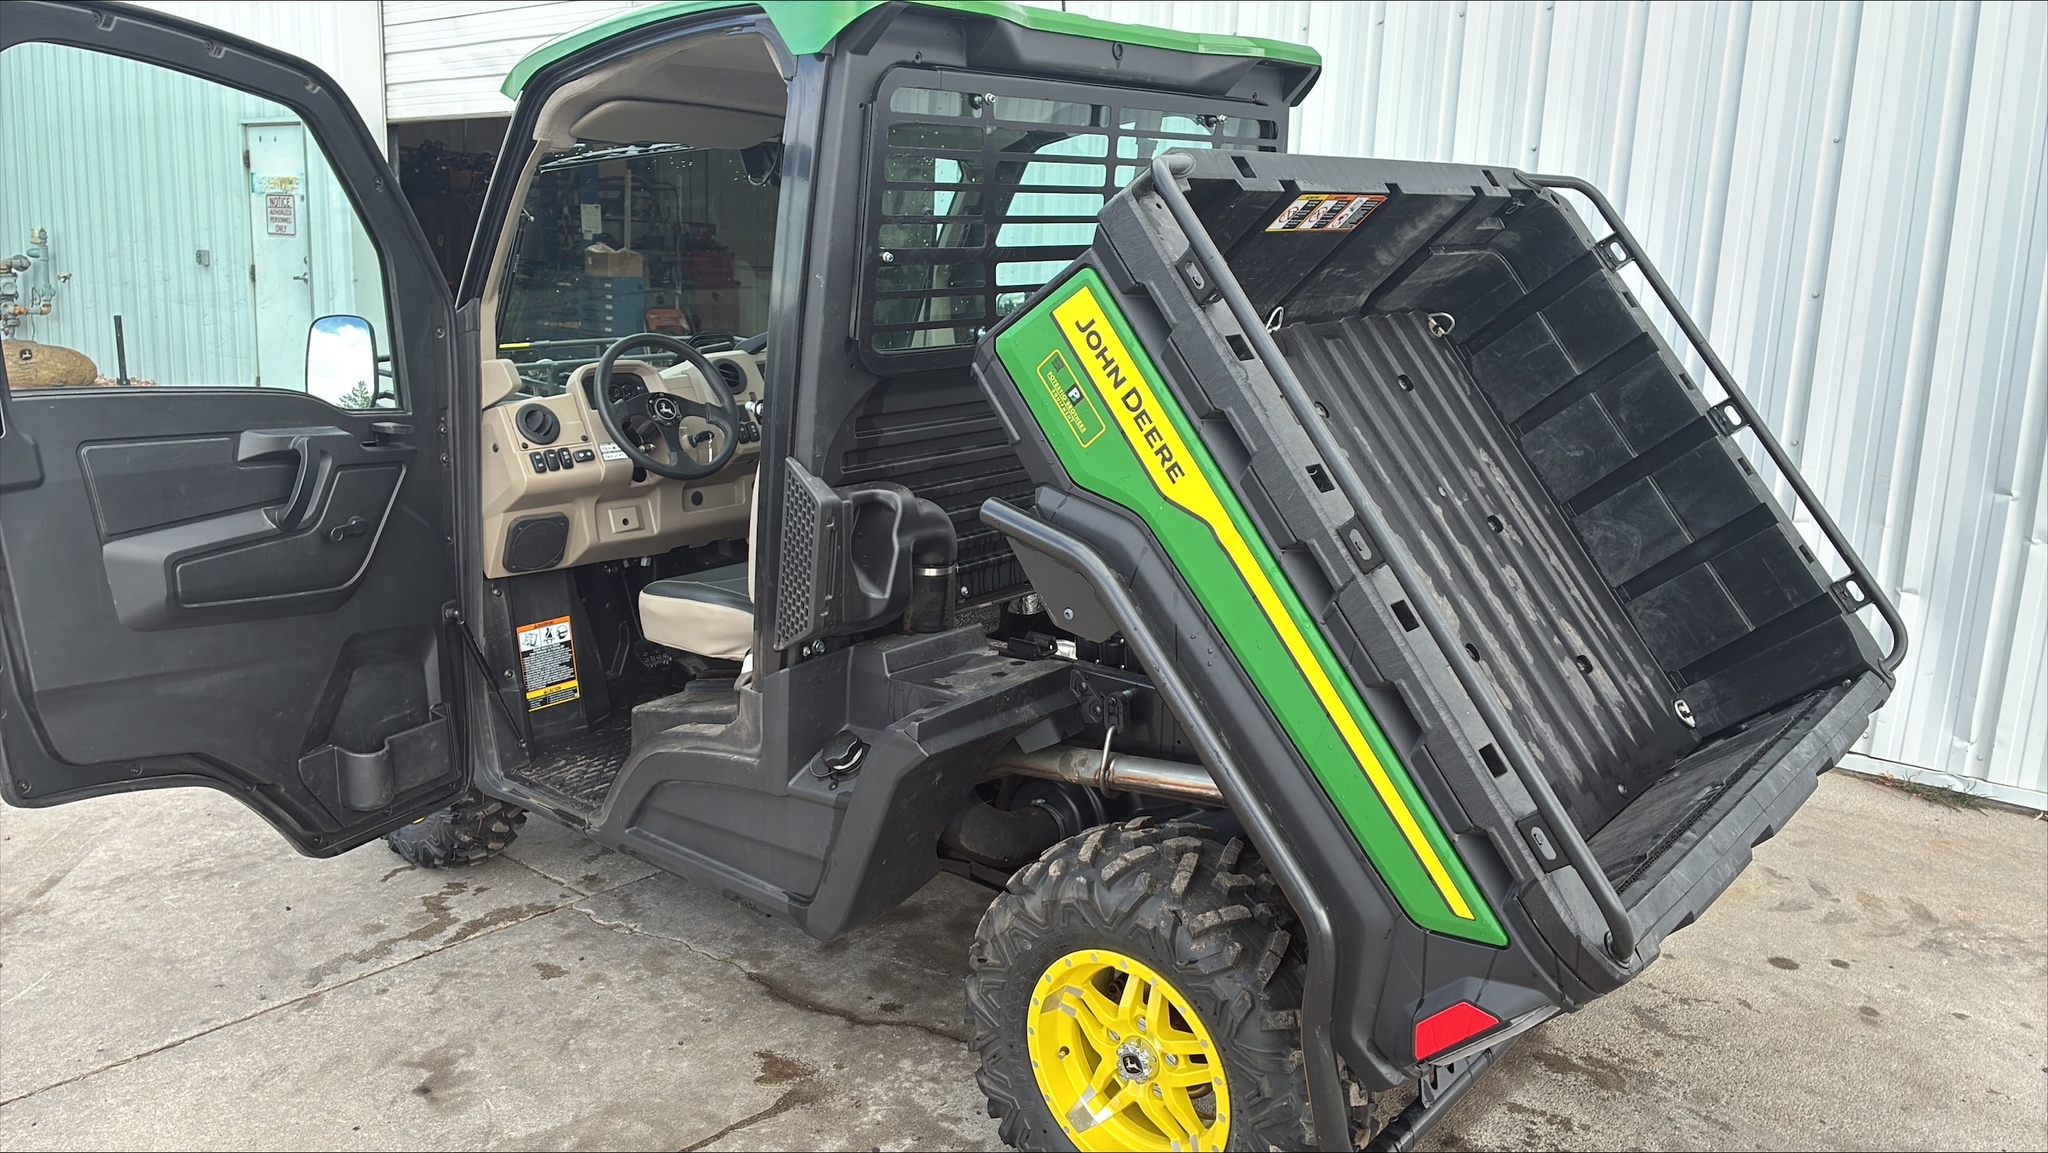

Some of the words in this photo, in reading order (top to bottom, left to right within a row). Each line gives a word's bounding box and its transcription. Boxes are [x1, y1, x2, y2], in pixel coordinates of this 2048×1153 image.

[270, 197, 290, 207] NOTICE
[275, 224, 287, 232] ONLY
[1046, 371, 1067, 401] POTESTIO
[1065, 400, 1087, 434] BROTHERS
[1051, 388, 1074, 423] EQUIPMENT
[1075, 319, 1127, 390] JOHN
[1121, 386, 1185, 485] DEERE
